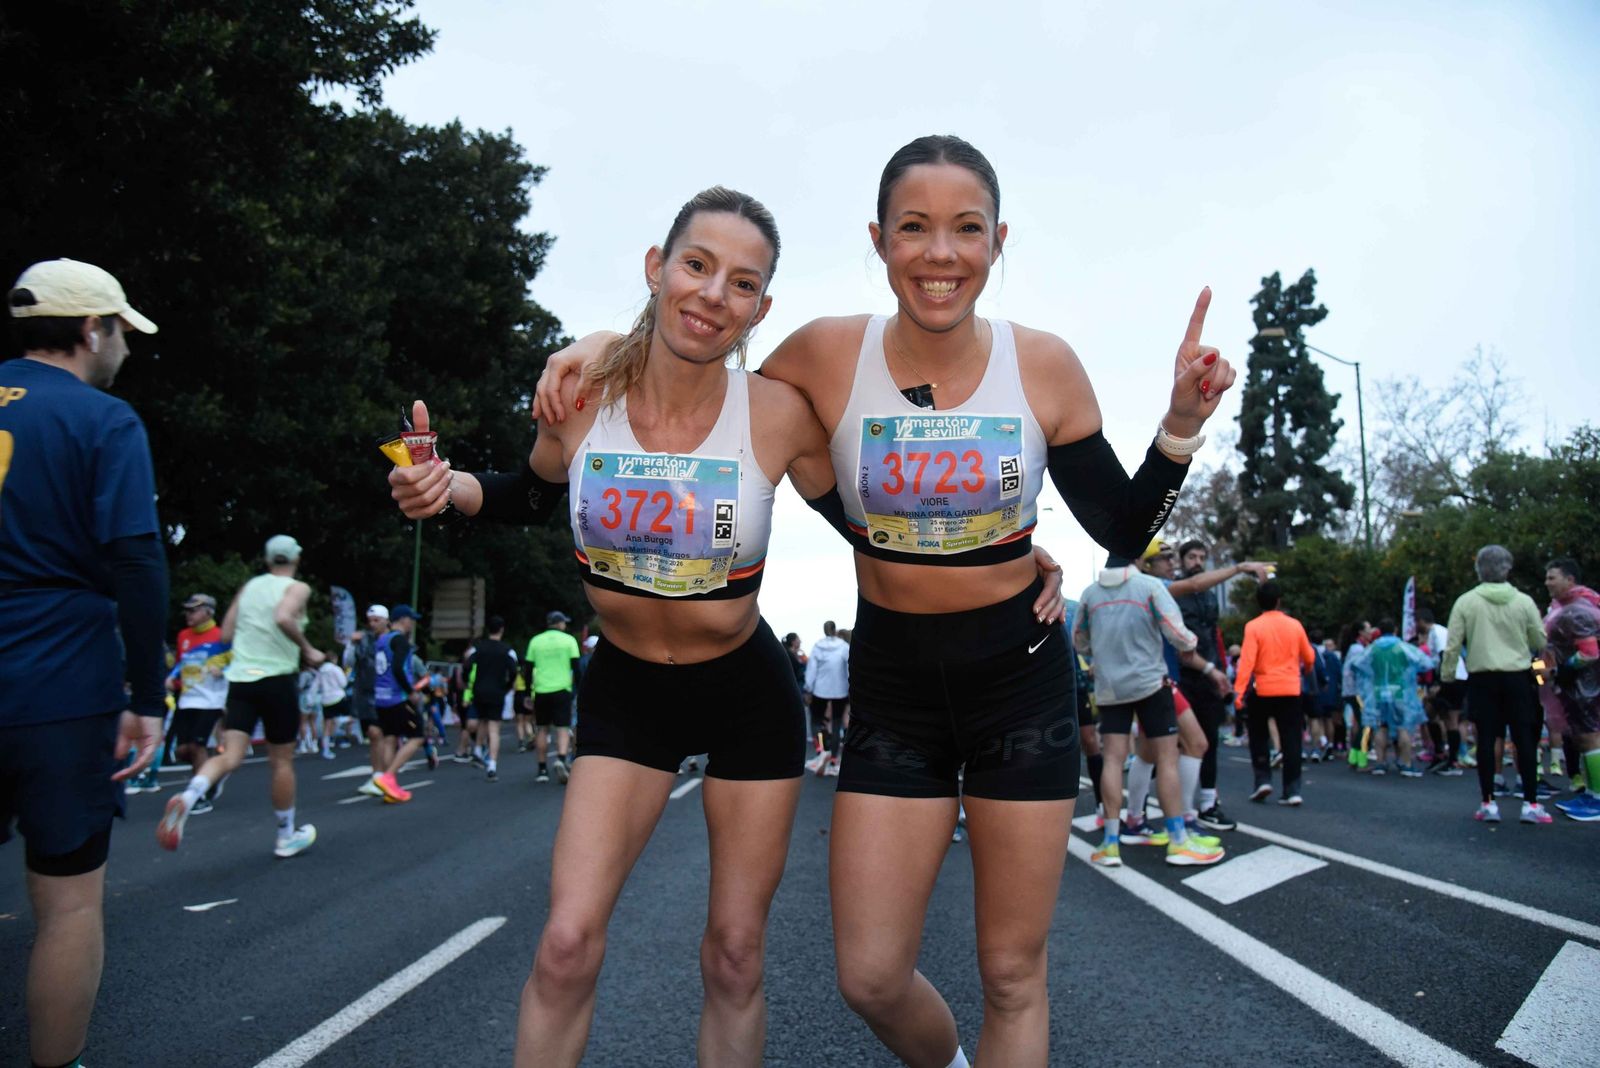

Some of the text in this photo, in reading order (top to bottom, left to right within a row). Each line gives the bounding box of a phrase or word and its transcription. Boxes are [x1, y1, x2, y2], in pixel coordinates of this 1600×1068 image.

[911, 417, 968, 428] maratón
[924, 426, 969, 438] sevilla
[632, 456, 687, 468] maratón
[644, 466, 688, 478] sevilla
[882, 450, 986, 496] 3723
[920, 497, 949, 506] VIORE
[600, 487, 696, 535] 3721
[894, 510, 926, 519] MARINA
[928, 510, 953, 518] OREA
[626, 534, 673, 546] Ana Burgos
[917, 540, 940, 548] HOKA
[612, 545, 628, 553] Ana
[663, 548, 691, 559] Burgos
[633, 573, 653, 585] HOKA
